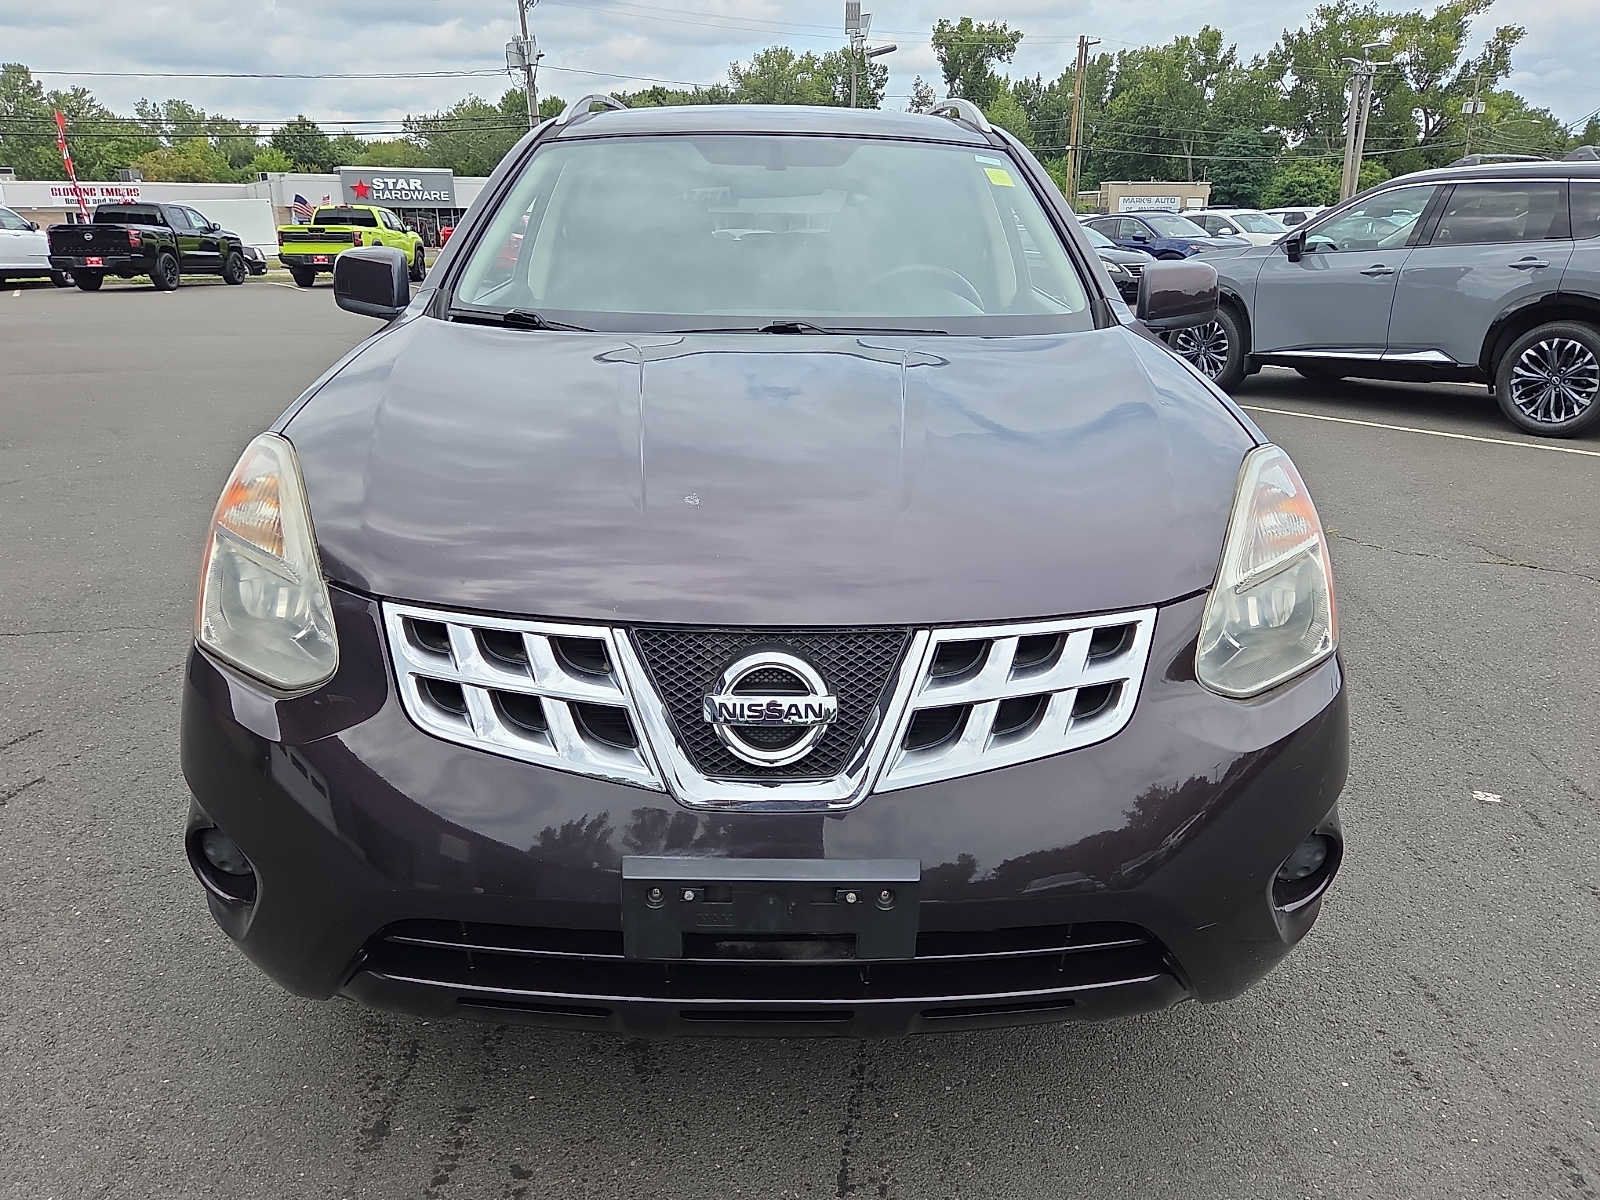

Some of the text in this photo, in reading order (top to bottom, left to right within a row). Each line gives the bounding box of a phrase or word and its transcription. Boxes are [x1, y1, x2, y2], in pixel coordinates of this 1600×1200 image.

[372, 178, 423, 190] STAR
[373, 190, 450, 201] HARDWARE
[718, 703, 823, 720] NISSAN
